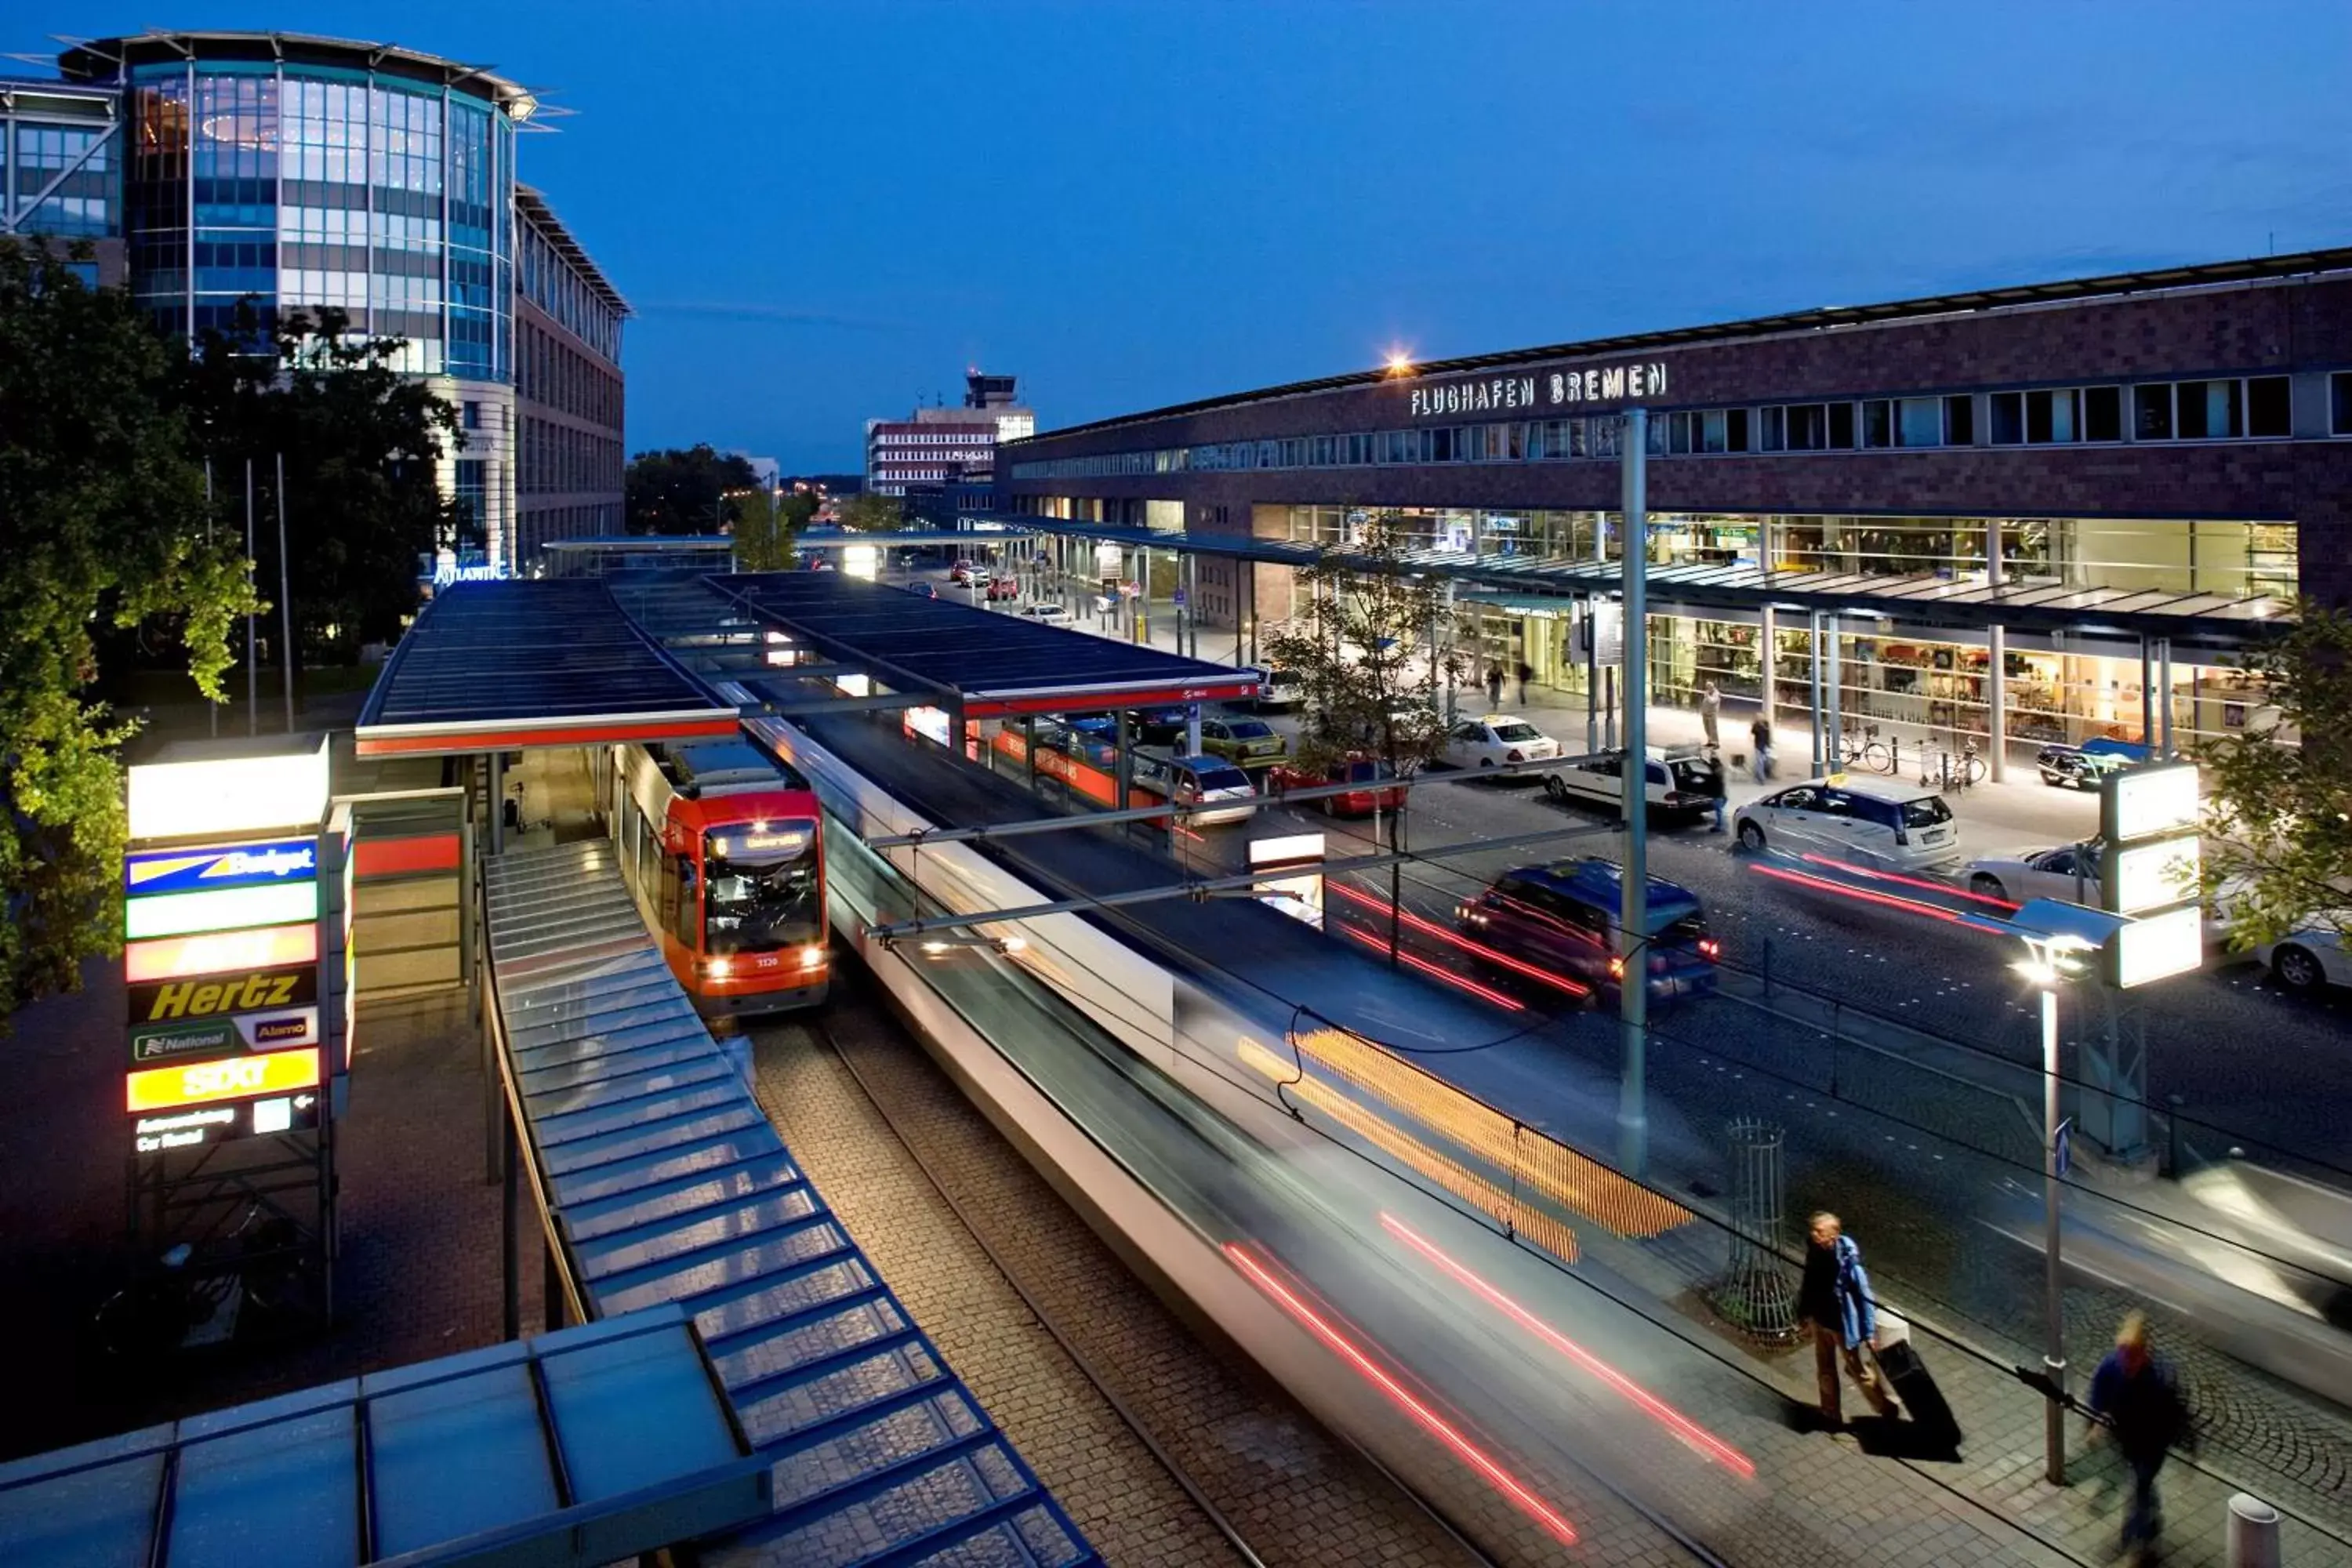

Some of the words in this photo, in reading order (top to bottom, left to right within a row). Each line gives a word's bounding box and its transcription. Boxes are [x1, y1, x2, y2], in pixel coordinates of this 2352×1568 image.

[1412, 377, 1534, 416] FLUGHAFEN
[1550, 363, 1666, 405] BREMEN
[229, 848, 315, 877] Budget
[148, 974, 299, 1022] Hertz
[165, 1033, 224, 1051] National
[259, 1024, 304, 1039] Alamo
